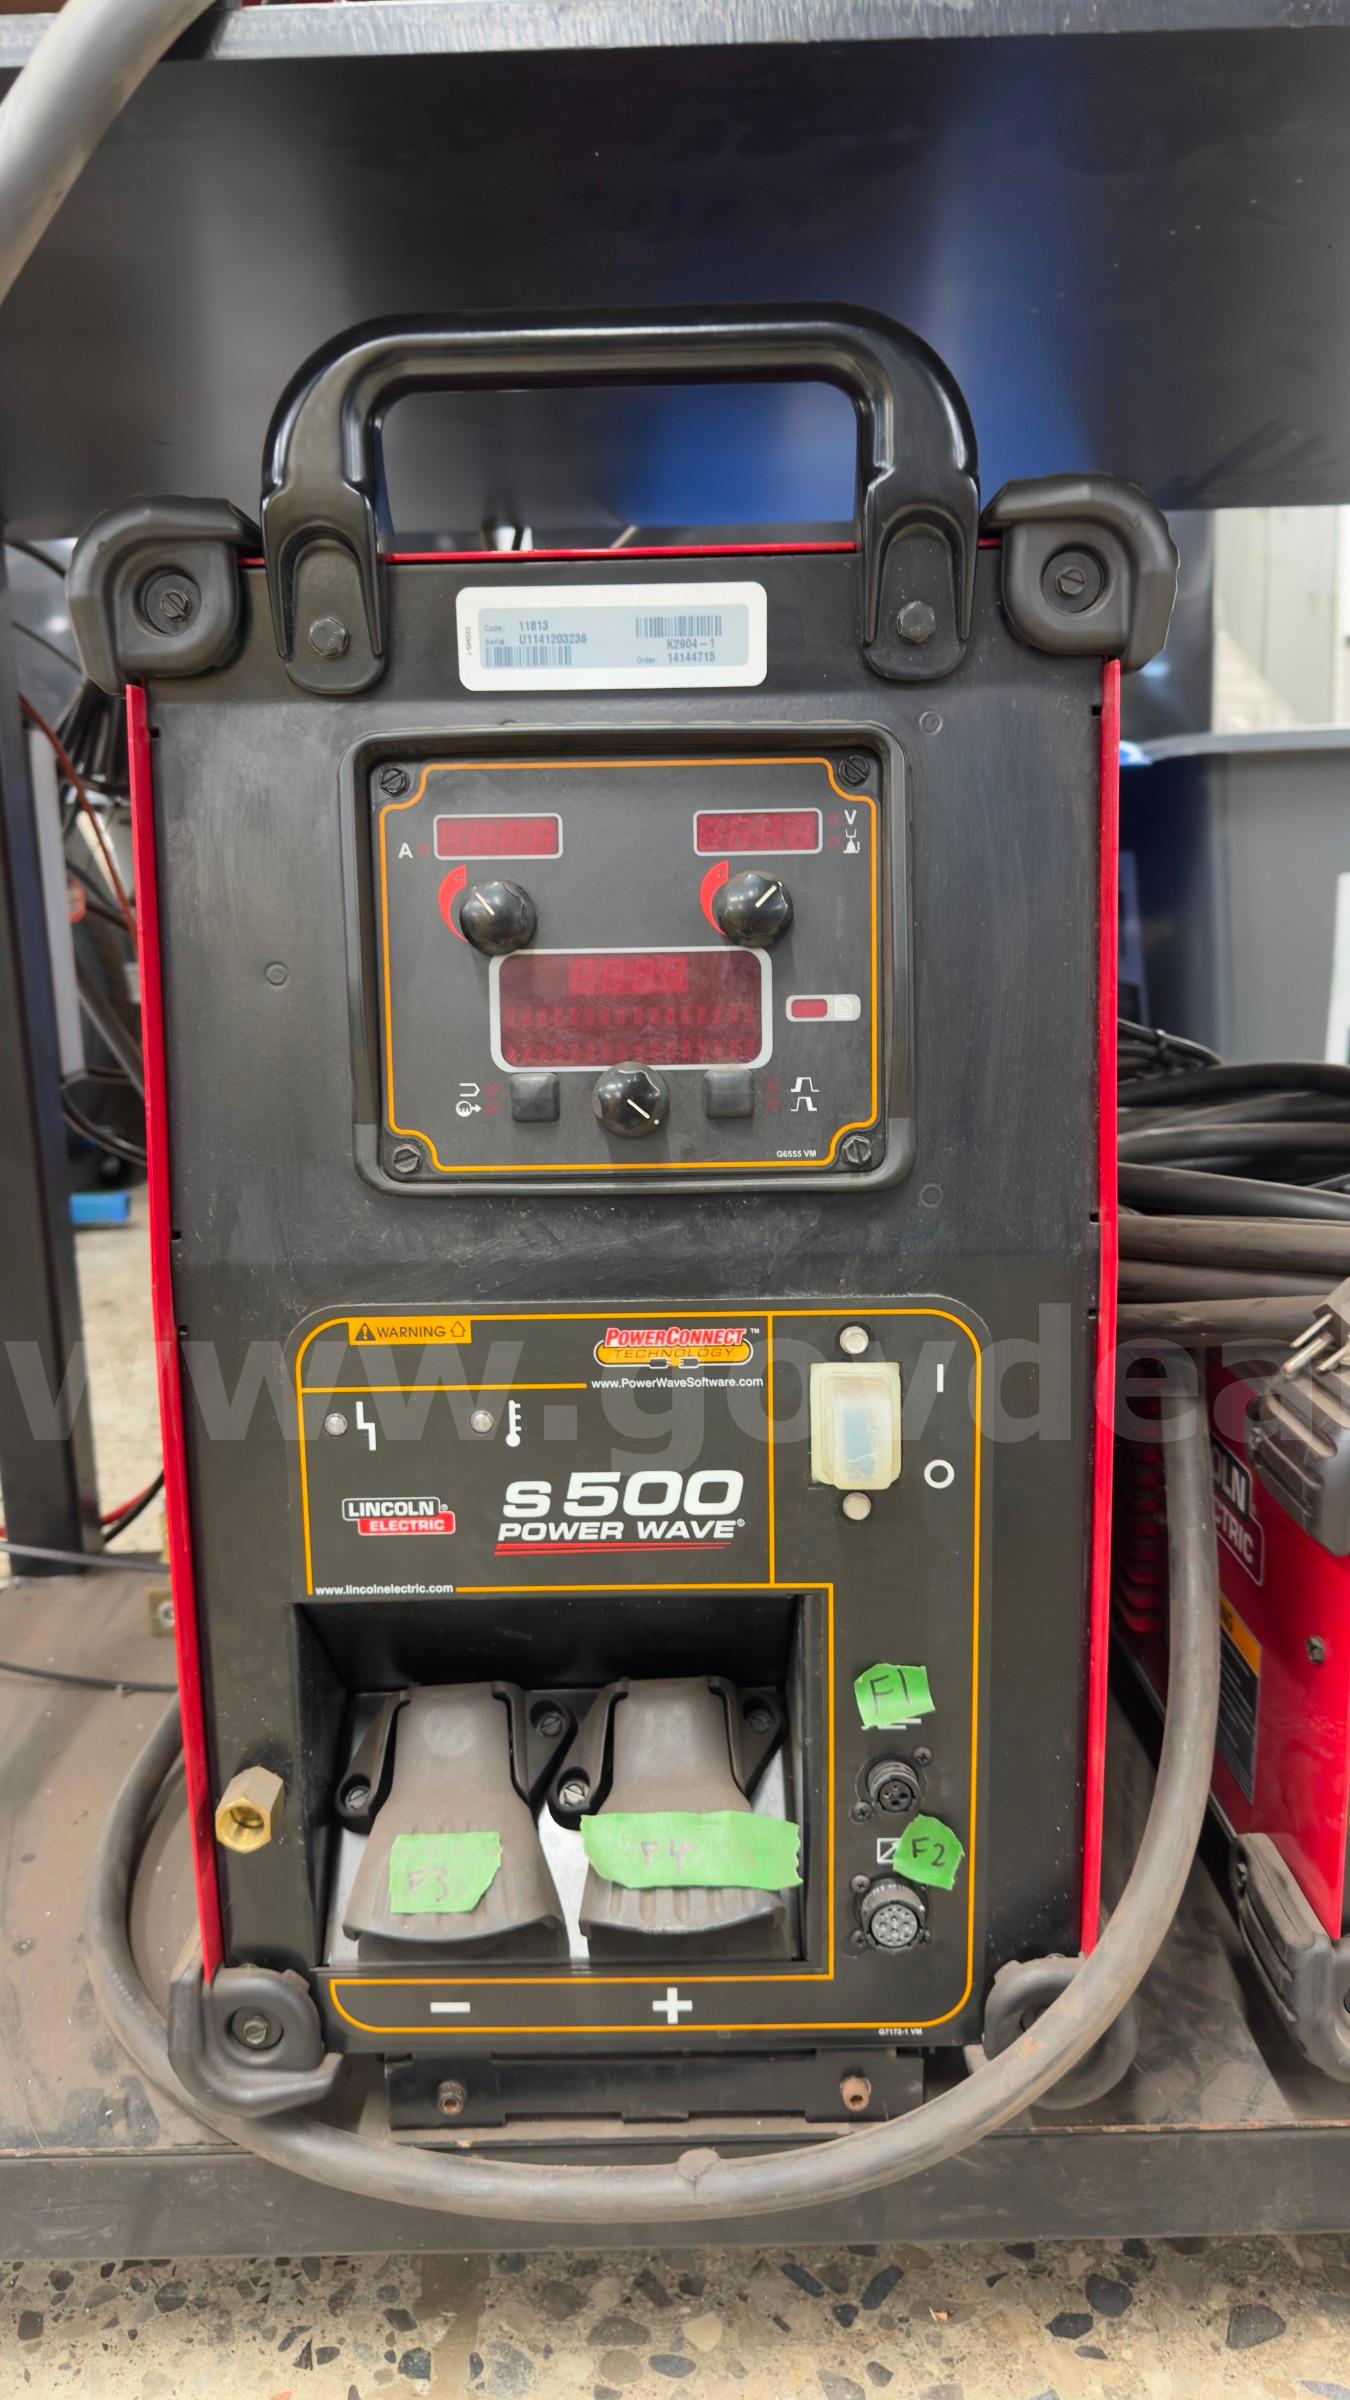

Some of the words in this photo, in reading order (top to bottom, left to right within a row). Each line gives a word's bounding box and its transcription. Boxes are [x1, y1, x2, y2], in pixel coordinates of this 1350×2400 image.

[518, 620, 549, 631] 11813
[844, 810, 857, 825] V
[398, 842, 414, 859] A
[376, 1326, 446, 1338] WARNING
[615, 1348, 736, 1359] TECHNOLOGY
[591, 1376, 764, 1389] www.PowerWaveSoftware.com
[563, 1469, 745, 1517] 500
[348, 1501, 435, 1517] LINCOLN
[369, 1519, 446, 1532] ELECTRIC
[498, 1521, 625, 1542] POWER
[315, 1583, 455, 1596] www.lincolnelectric.com
[869, 1668, 911, 1715] F1
[641, 1837, 691, 1875] F4
[911, 1837, 945, 1867] F2
[408, 1866, 449, 1903] F3
